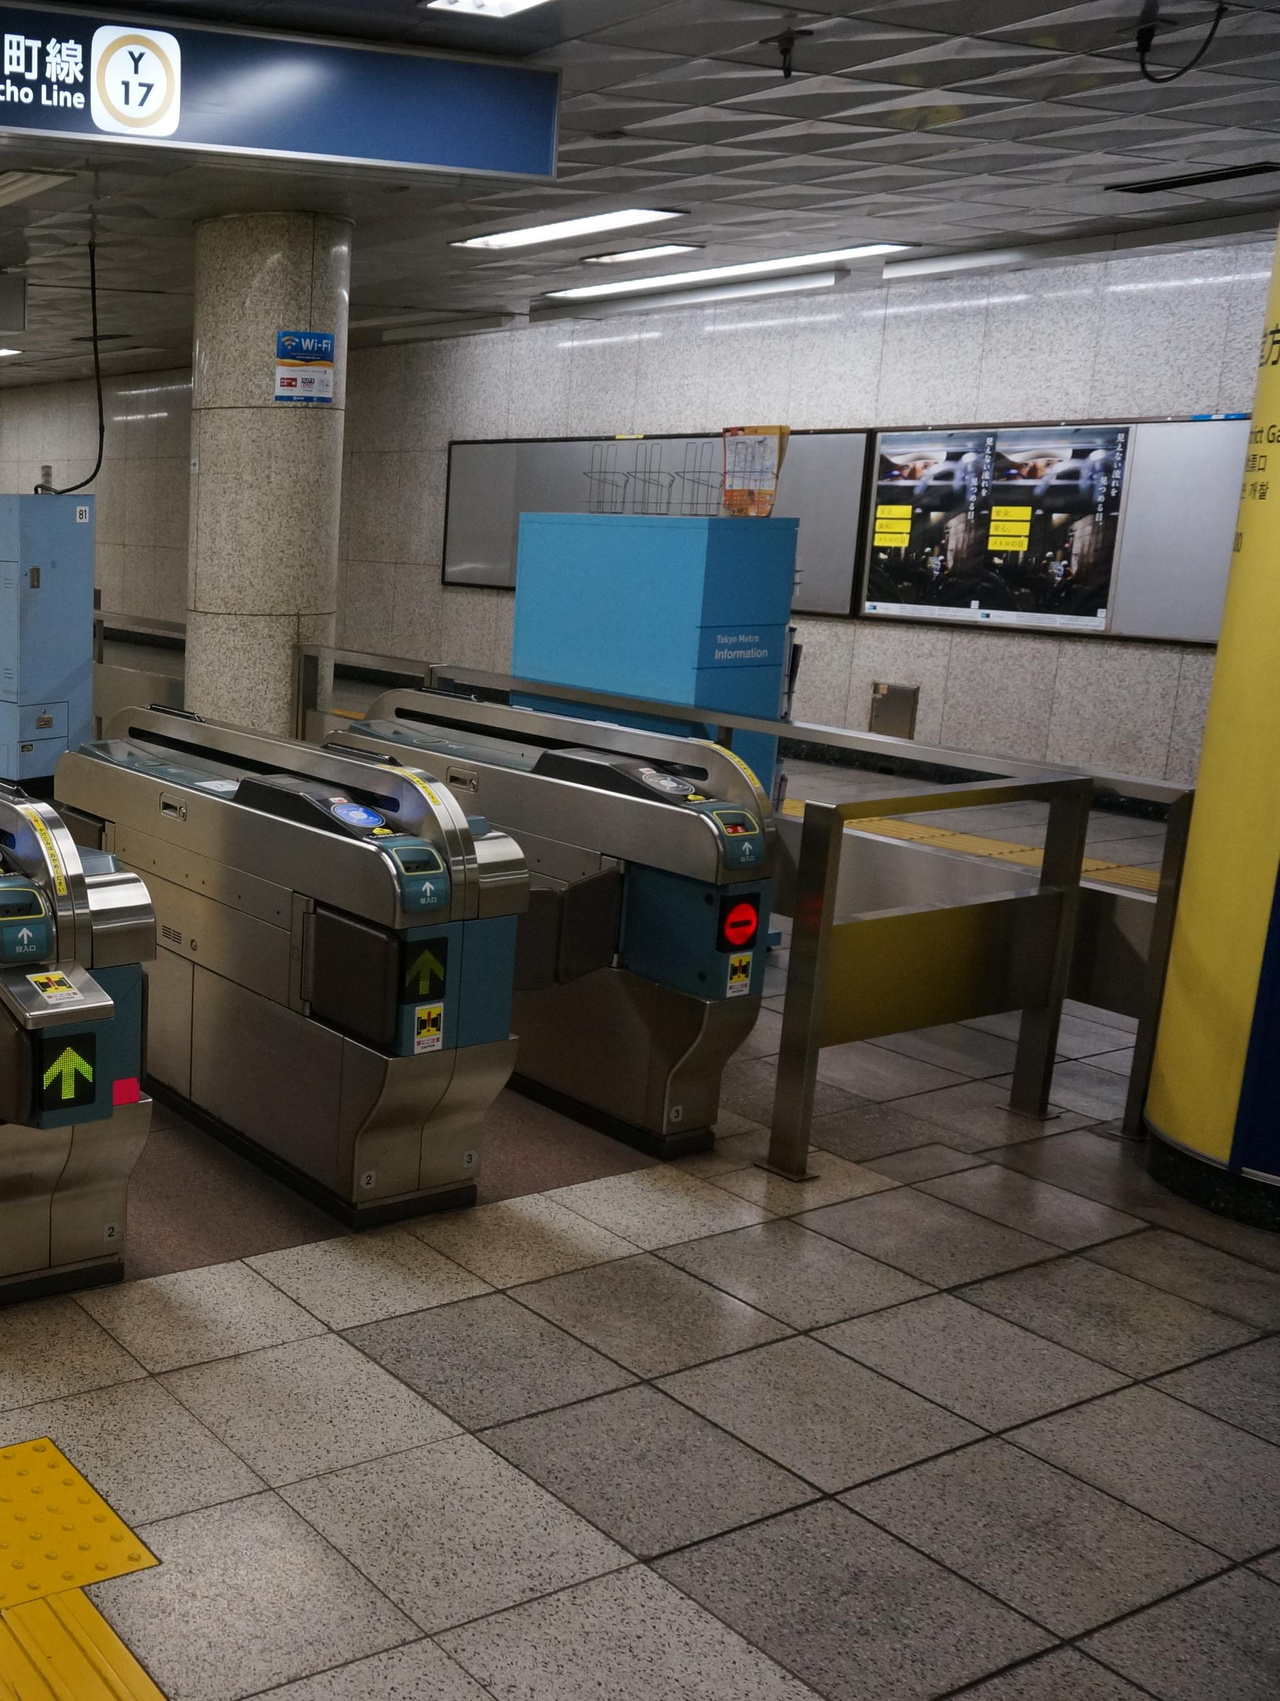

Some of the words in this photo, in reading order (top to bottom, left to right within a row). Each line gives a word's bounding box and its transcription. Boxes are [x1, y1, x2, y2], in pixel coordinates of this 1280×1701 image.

[127, 50, 146, 75] Y
[41, 84, 84, 109] Line
[121, 80, 154, 107] 17
[301, 338, 331, 352] Wi-Fi
[981, 437, 994, 496] 見えない流れを
[1110, 433, 1126, 496] 見えない流れを
[78, 509, 87, 519] 81
[716, 634, 737, 645] Tokyo
[738, 634, 760, 643] Metro
[714, 648, 769, 660] Information
[15, 944, 37, 953] 投入口
[673, 1109, 680, 1119] 3
[466, 1153, 473, 1164] 3
[365, 1174, 373, 1185] 2
[107, 1226, 115, 1238] 2
